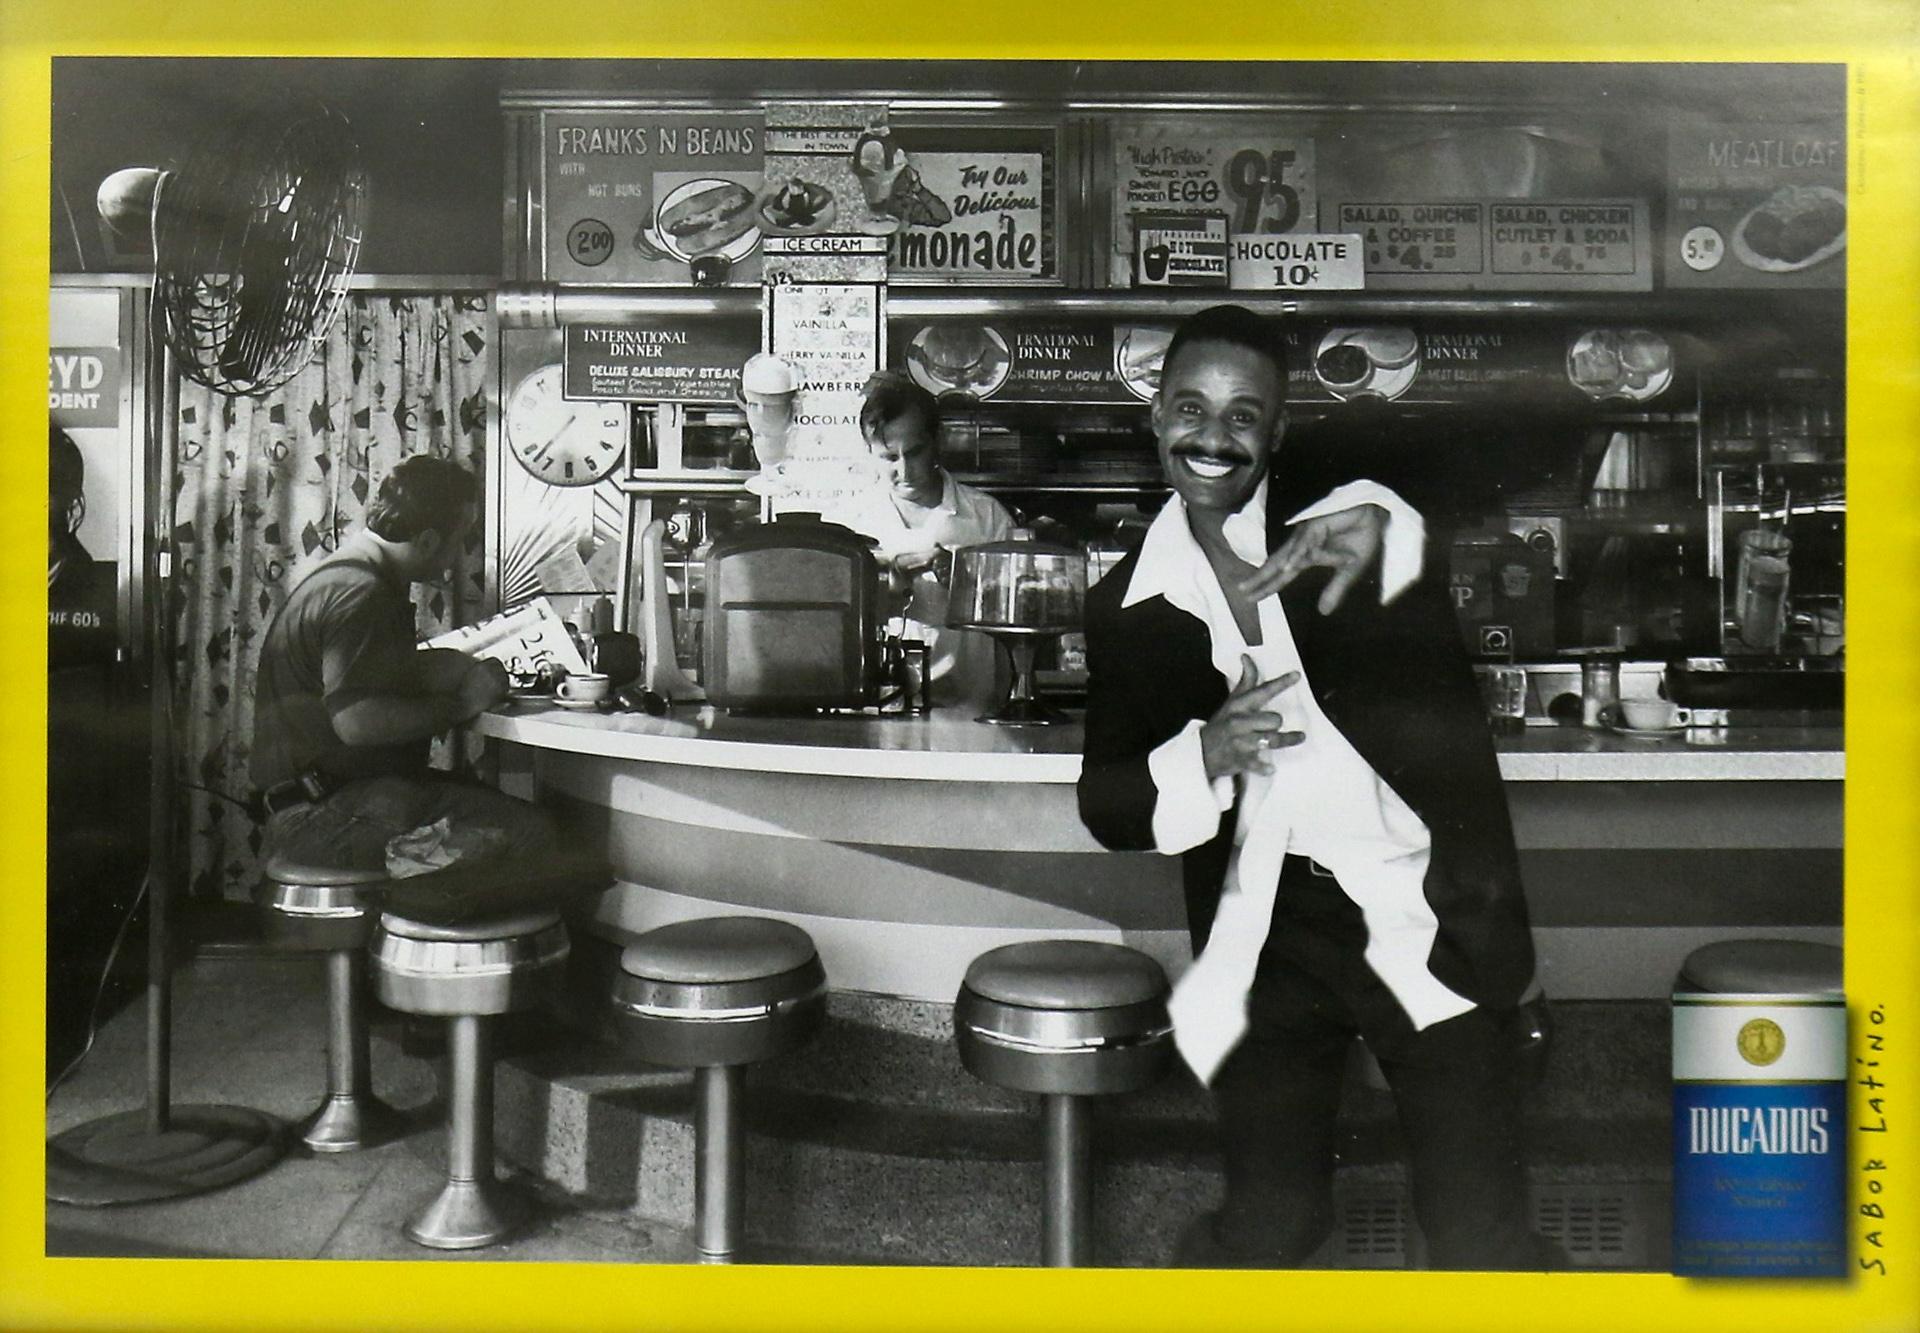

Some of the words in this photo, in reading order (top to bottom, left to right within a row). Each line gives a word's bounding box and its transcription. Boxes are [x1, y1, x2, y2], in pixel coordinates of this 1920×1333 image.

[558, 127, 647, 155] FRANKS
[687, 127, 755, 155] BEANS
[1708, 139, 1840, 168] MEATLOAF
[559, 161, 585, 176] WITH
[958, 165, 989, 188] Try
[992, 166, 1028, 186] Our
[1168, 180, 1220, 203] EGG
[953, 191, 1041, 217] Delicious
[1413, 207, 1478, 223] QUICHE
[1559, 208, 1629, 224] CHICKEN
[1366, 228, 1379, 243] &
[1387, 228, 1456, 243] COFFEE
[1495, 228, 1557, 243] CUTLET
[1584, 228, 1629, 243] SODA
[783, 239, 808, 251] ICE
[810, 238, 862, 252] CREAM
[584, 329, 688, 344] INTERNATIONAL
[610, 343, 663, 358] DINNER
[1018, 346, 1071, 360] DINNER
[1426, 347, 1479, 360] DINNER
[49, 355, 104, 389] YD
[698, 367, 742, 379] STEAK
[1065, 369, 1103, 381] CHOW
[797, 381, 865, 391] AWBERR
[1688, 1107, 1829, 1155] DUCADOS
[1858, 1159, 1888, 1276] SABOR
